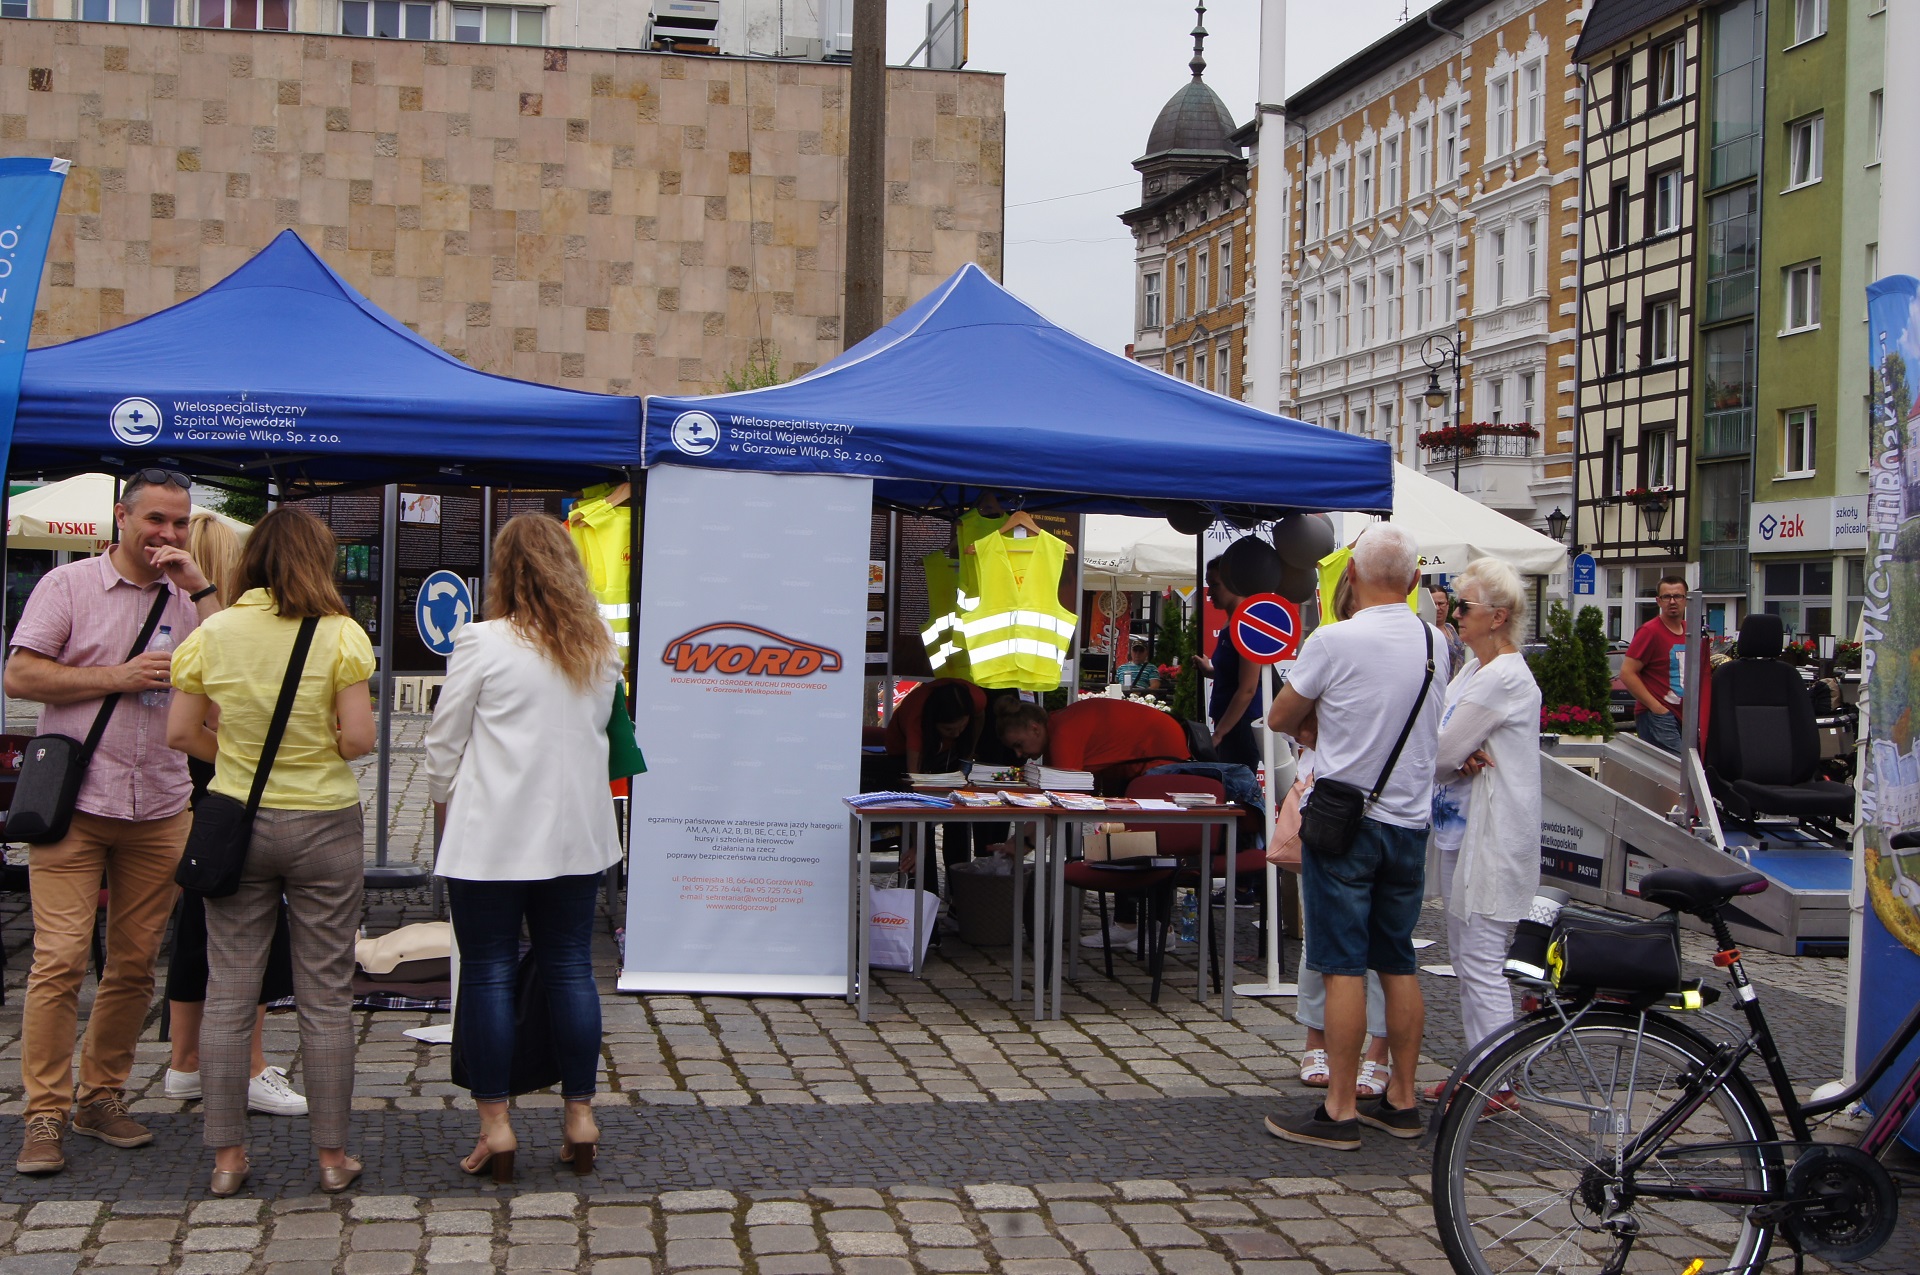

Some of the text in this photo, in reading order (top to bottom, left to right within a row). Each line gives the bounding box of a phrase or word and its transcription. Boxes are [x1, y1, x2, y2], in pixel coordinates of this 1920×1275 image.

[174, 401, 306, 416] Wielospecjalistyczny
[174, 415, 296, 428] Szpital Wojewódzki
[730, 415, 854, 434] Wielospecjalistyczny
[174, 430, 341, 444] w Gorzowie Wlkp. Sp. z o.o.
[730, 428, 843, 445] Szpital Wojewódzki
[742, 442, 796, 456] Gorzowie
[800, 446, 831, 459] Wlkp.
[834, 448, 851, 461] Sp.
[855, 452, 861, 460] z
[864, 454, 884, 463] o.o.
[1836, 506, 1858, 519] szkoły
[46, 521, 97, 535] TYSKIE
[1780, 514, 1804, 538] żak
[1836, 523, 1867, 536] policealn
[1420, 556, 1446, 566] S.A.
[675, 644, 823, 676] WORD
[790, 821, 808, 829] jazdy
[1541, 821, 1584, 840] jewódzka Policji
[780, 856, 820, 864] drogowego
[682, 876, 724, 884] Podmiejska
